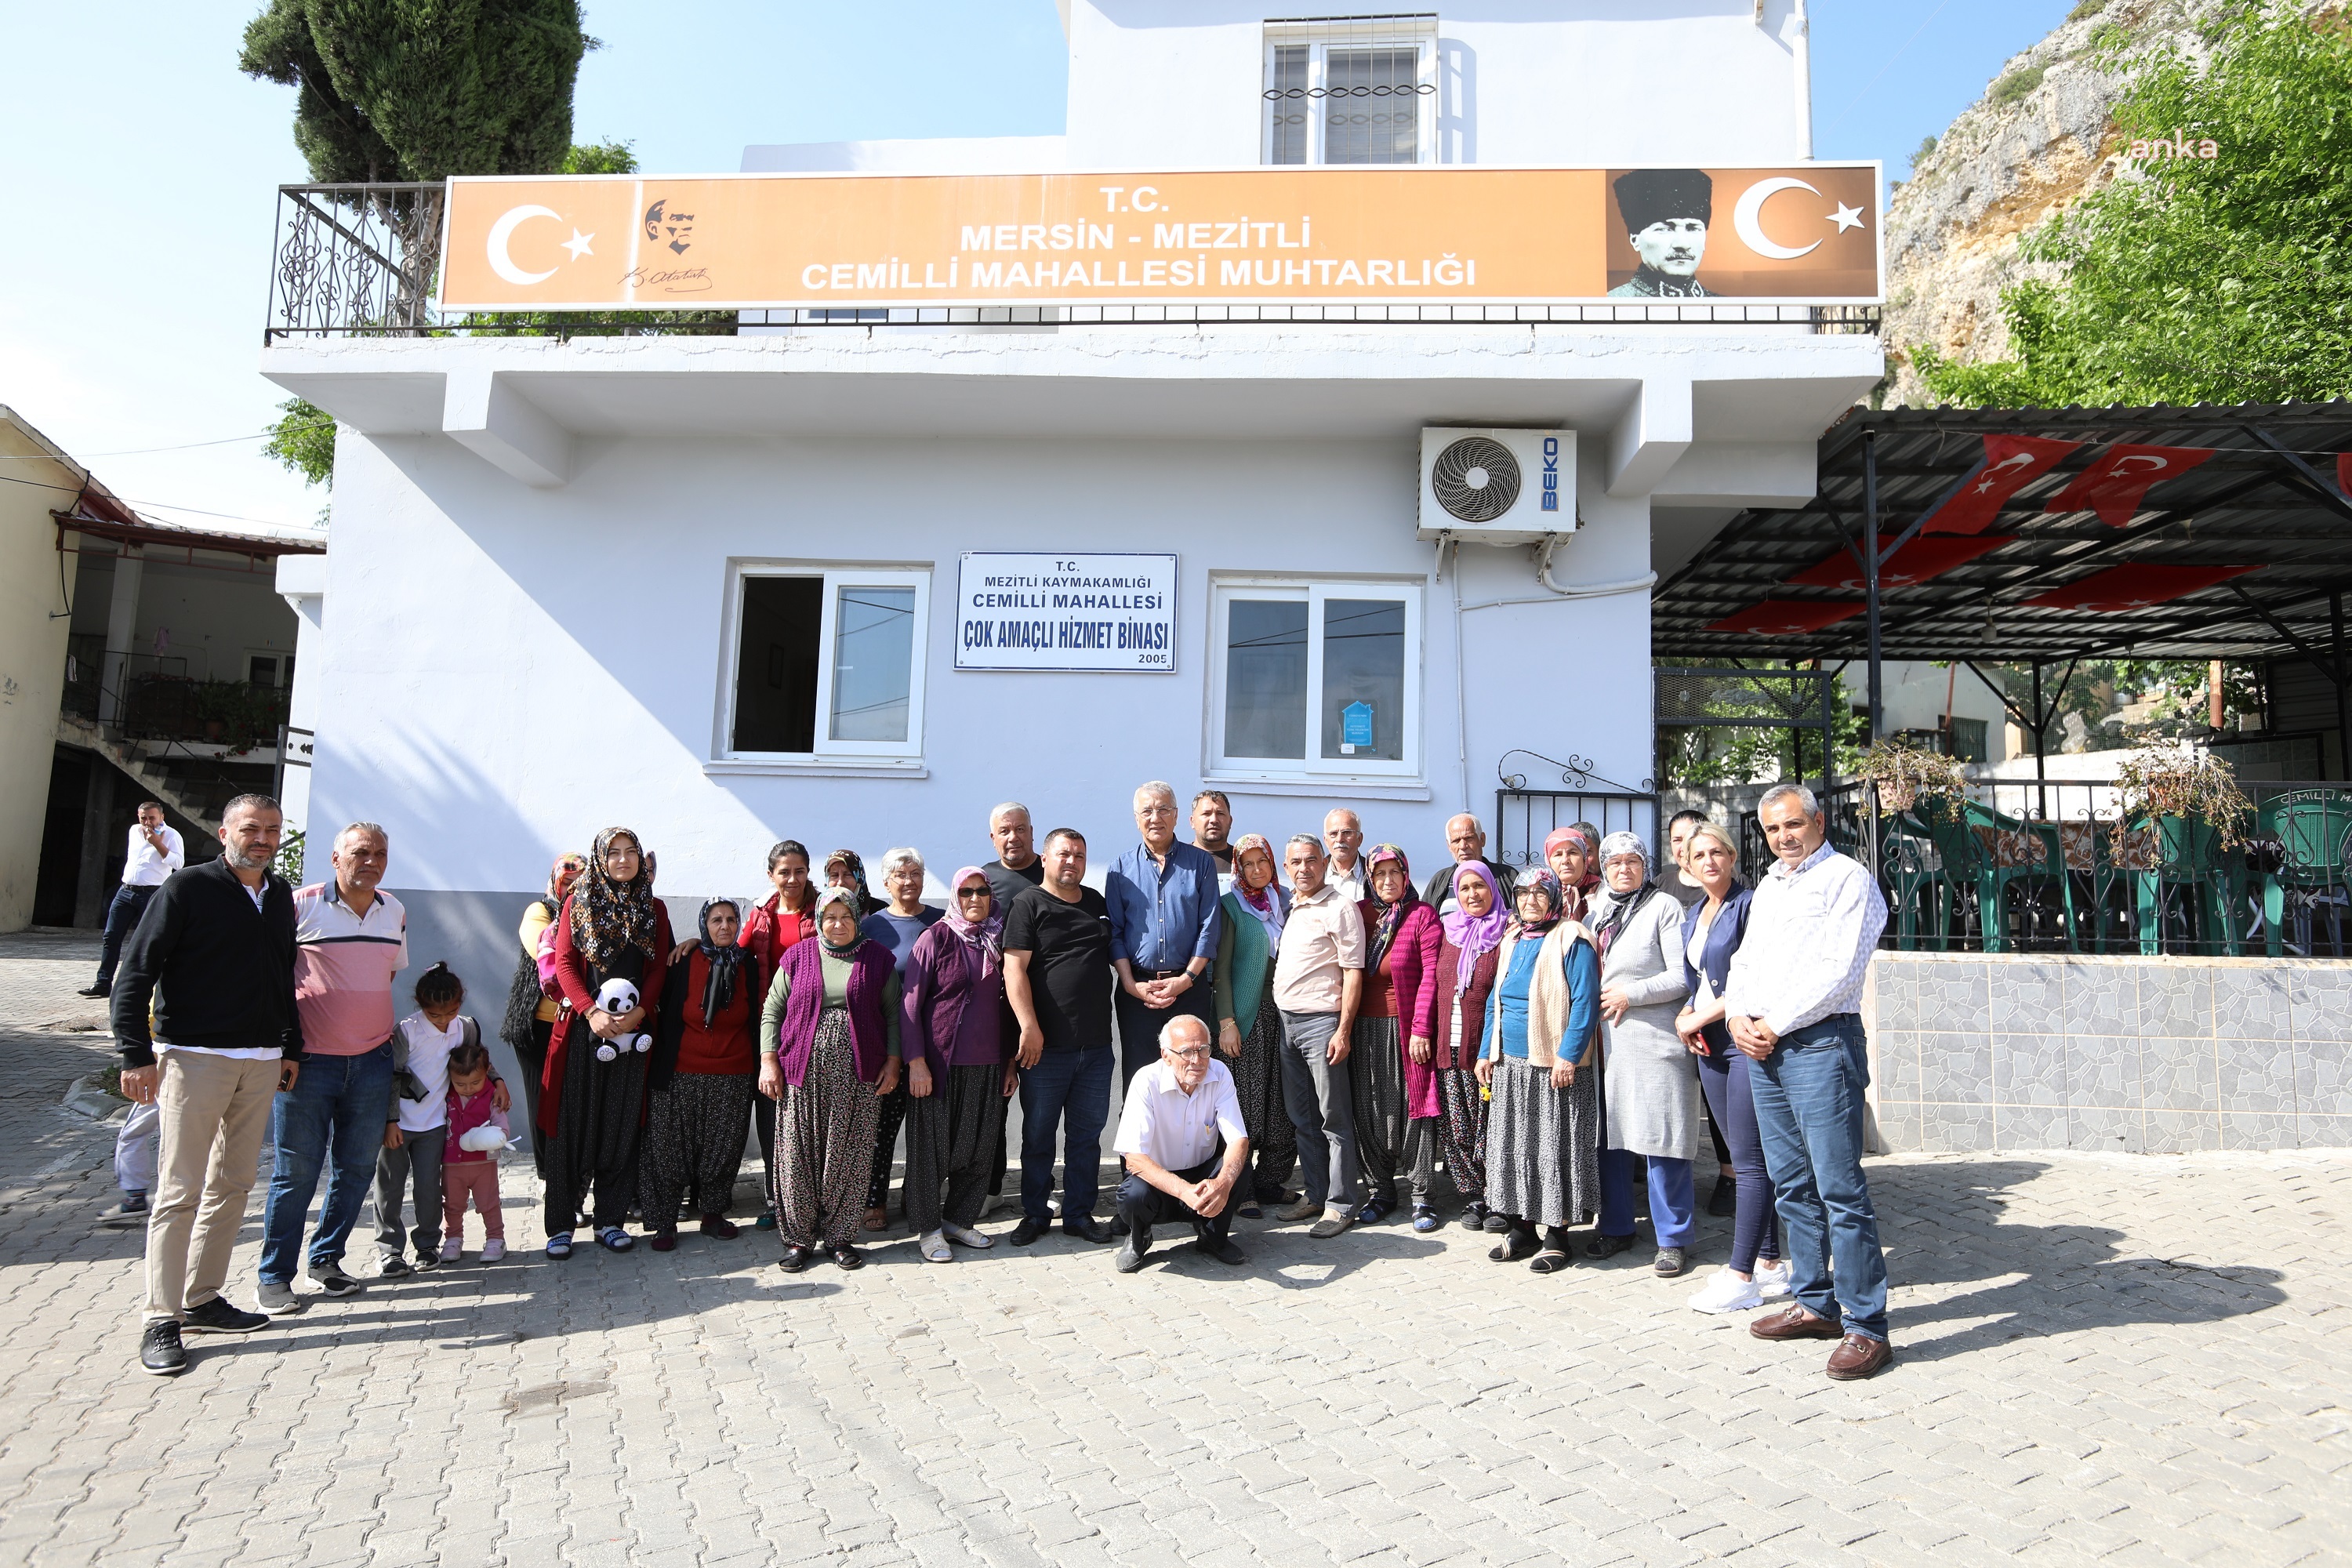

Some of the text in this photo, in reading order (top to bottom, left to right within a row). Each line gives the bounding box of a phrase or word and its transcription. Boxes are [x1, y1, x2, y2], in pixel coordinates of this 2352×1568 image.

[1099, 186, 1169, 212] T.C.
[960, 218, 1113, 251] MERSİN
[1153, 216, 1310, 249] MEZİTLİ
[801, 252, 1475, 289] CEMİLLİ MAHALLESİ MUHTARLIĞI
[1543, 437, 1558, 510] BEKO
[1055, 561, 1080, 572] T.C.
[985, 574, 1151, 588] MEZİTLİ KAYMAKAMLIĞI
[972, 590, 1163, 609] CEMİLLİ MAHALLESİ
[964, 615, 1168, 652] ÇOK AMAÇLI HİZMET BİNASI
[1138, 654, 1167, 663] 2005
